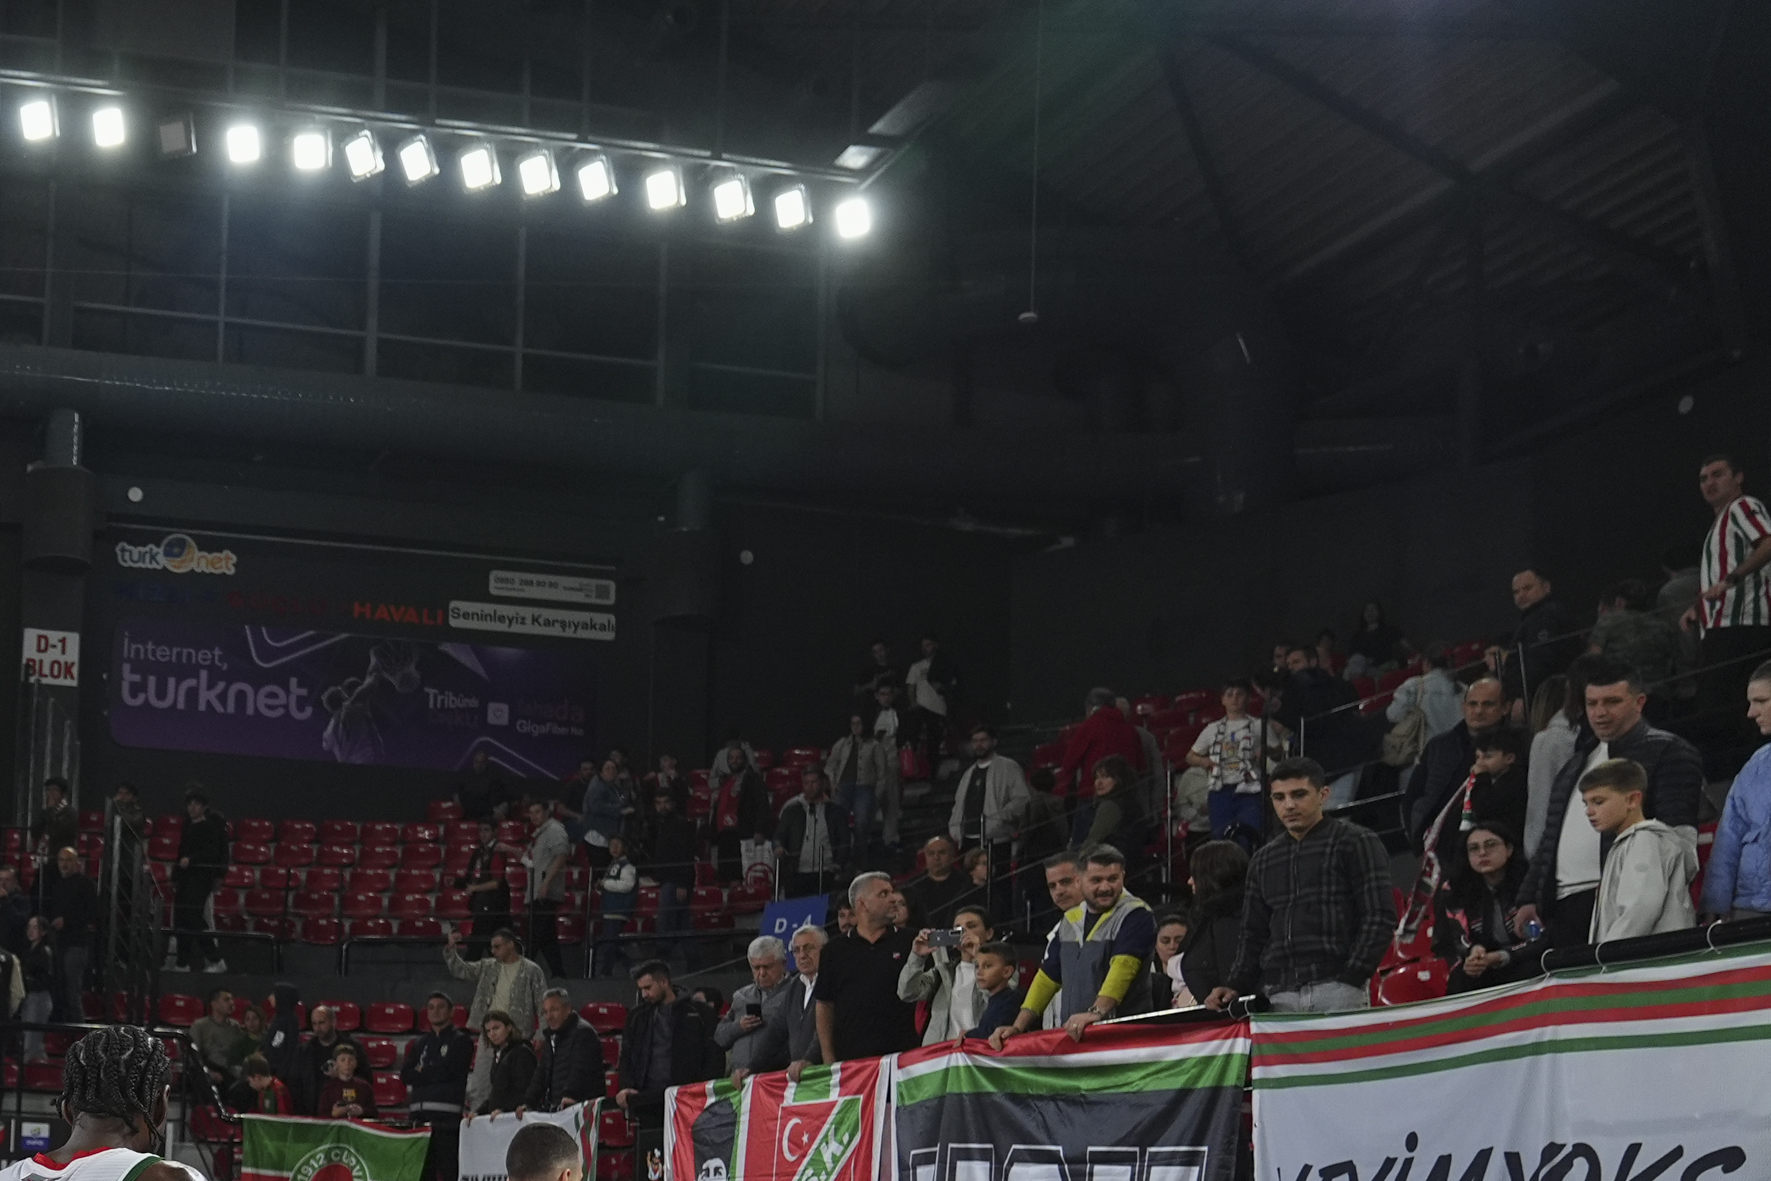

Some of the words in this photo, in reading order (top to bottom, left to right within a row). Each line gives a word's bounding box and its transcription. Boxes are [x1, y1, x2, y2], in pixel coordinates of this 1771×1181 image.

[353, 601, 444, 627] HAVALI
[451, 606, 527, 629] Seninleyiz
[34, 634, 69, 655] D-1
[25, 658, 77, 681] BLOK
[121, 664, 314, 720] turknet
[297, 1152, 327, 1181] 1912
